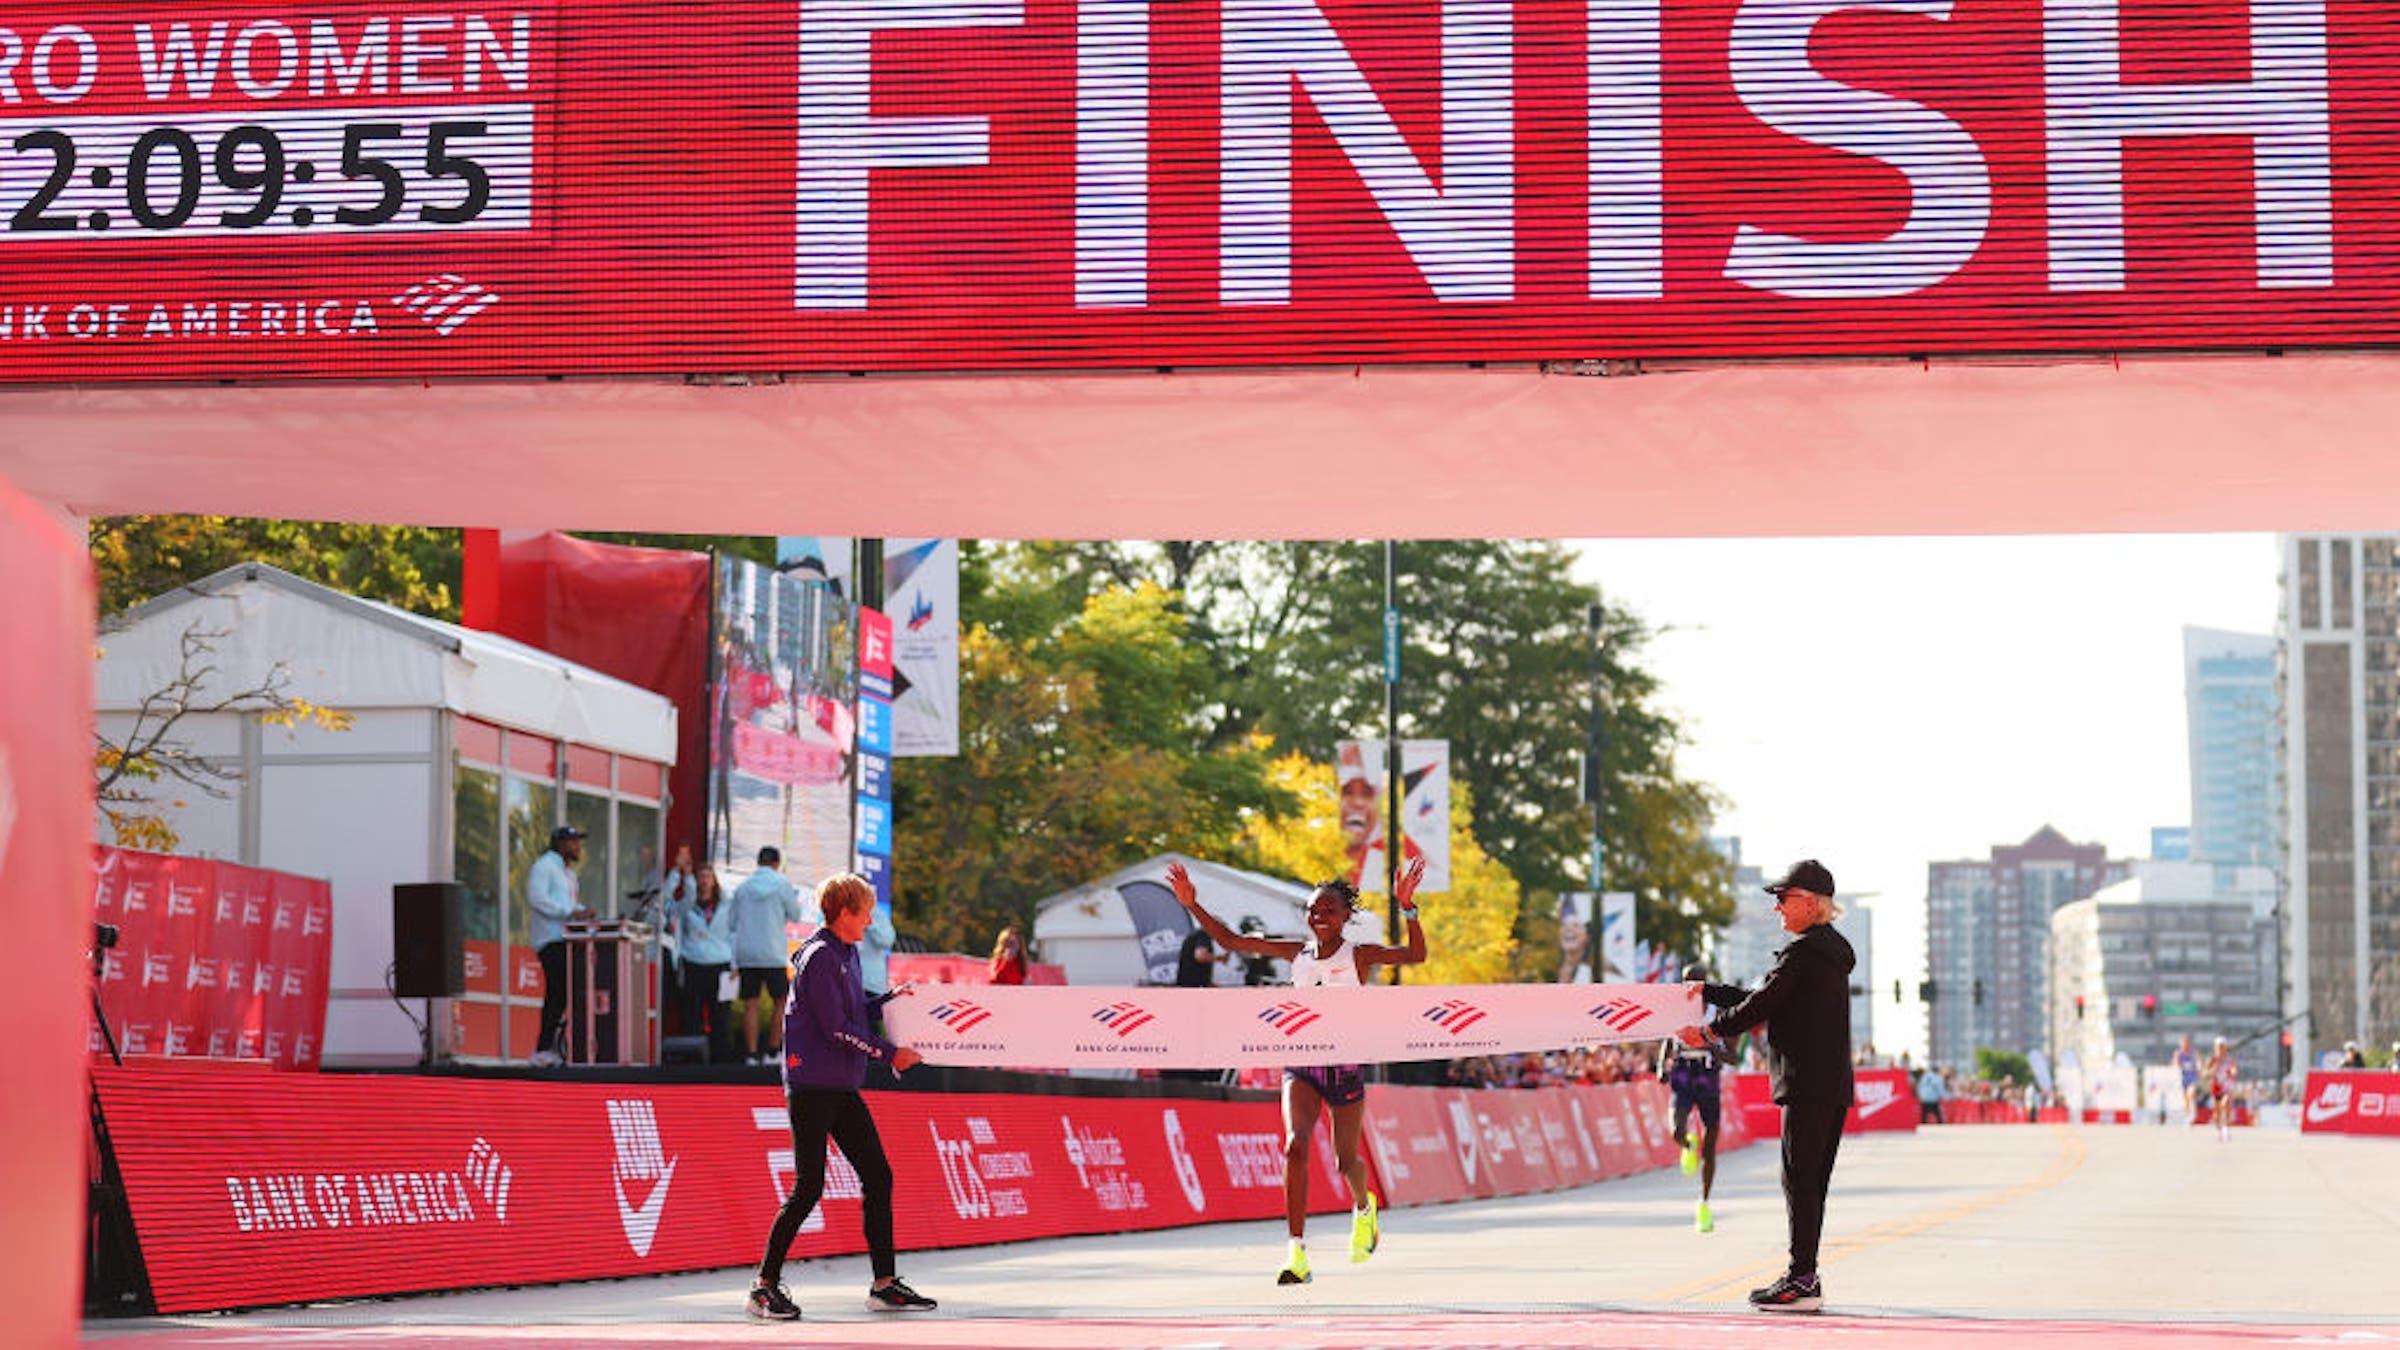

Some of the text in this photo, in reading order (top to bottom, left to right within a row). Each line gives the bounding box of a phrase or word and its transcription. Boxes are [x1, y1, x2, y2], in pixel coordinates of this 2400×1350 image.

[131, 14, 531, 100] WOMEN
[9, 120, 492, 232] 2:09:55
[794, 0, 2334, 310] FINISH
[66, 302, 130, 339] OF
[144, 300, 379, 339] AMERICA
[226, 1171, 476, 1232] BANK OF AMERICA
[928, 1117, 991, 1220] tcs
